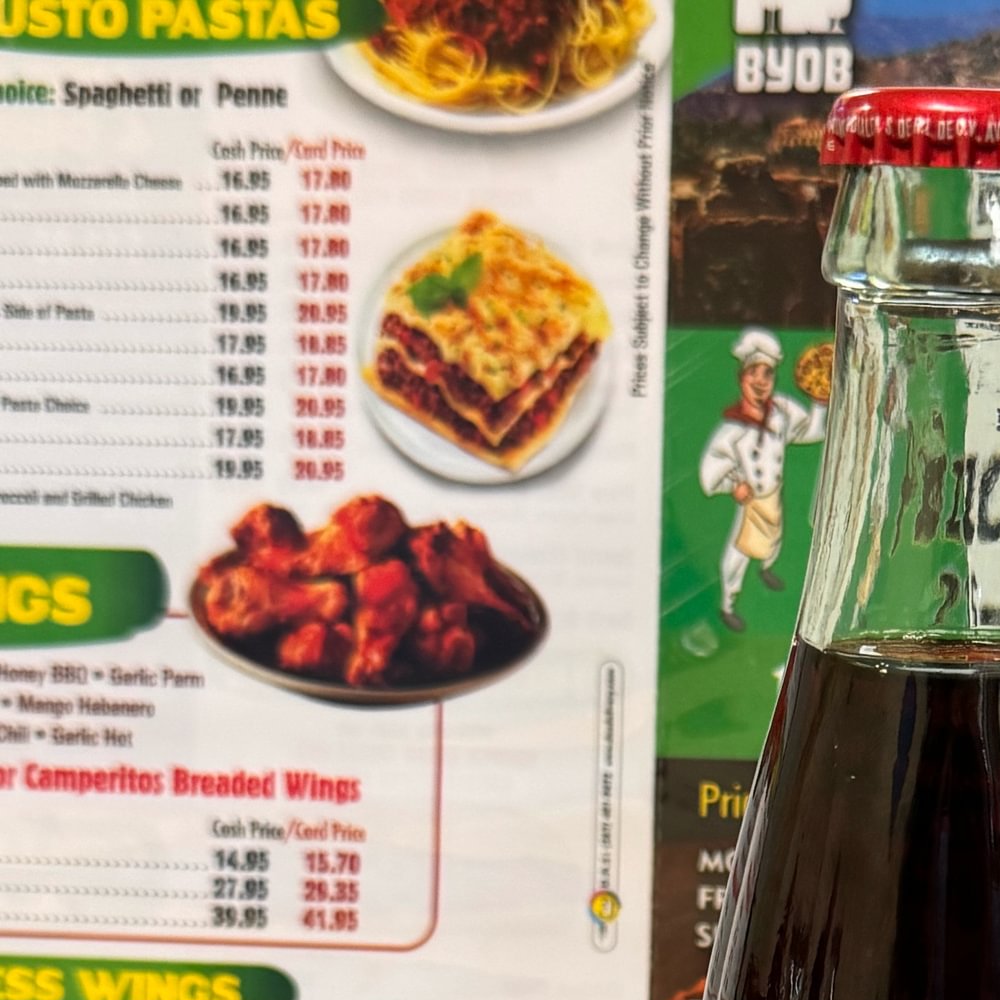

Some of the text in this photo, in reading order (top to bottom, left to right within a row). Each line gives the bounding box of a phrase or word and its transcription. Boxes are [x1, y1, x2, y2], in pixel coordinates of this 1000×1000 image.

[140, 0, 341, 40] PASTAS
[735, 43, 853, 93] BYOB
[64, 82, 288, 109] Spaghetti Penne
[23, 763, 362, 804] Camperitos Breaded Wings
